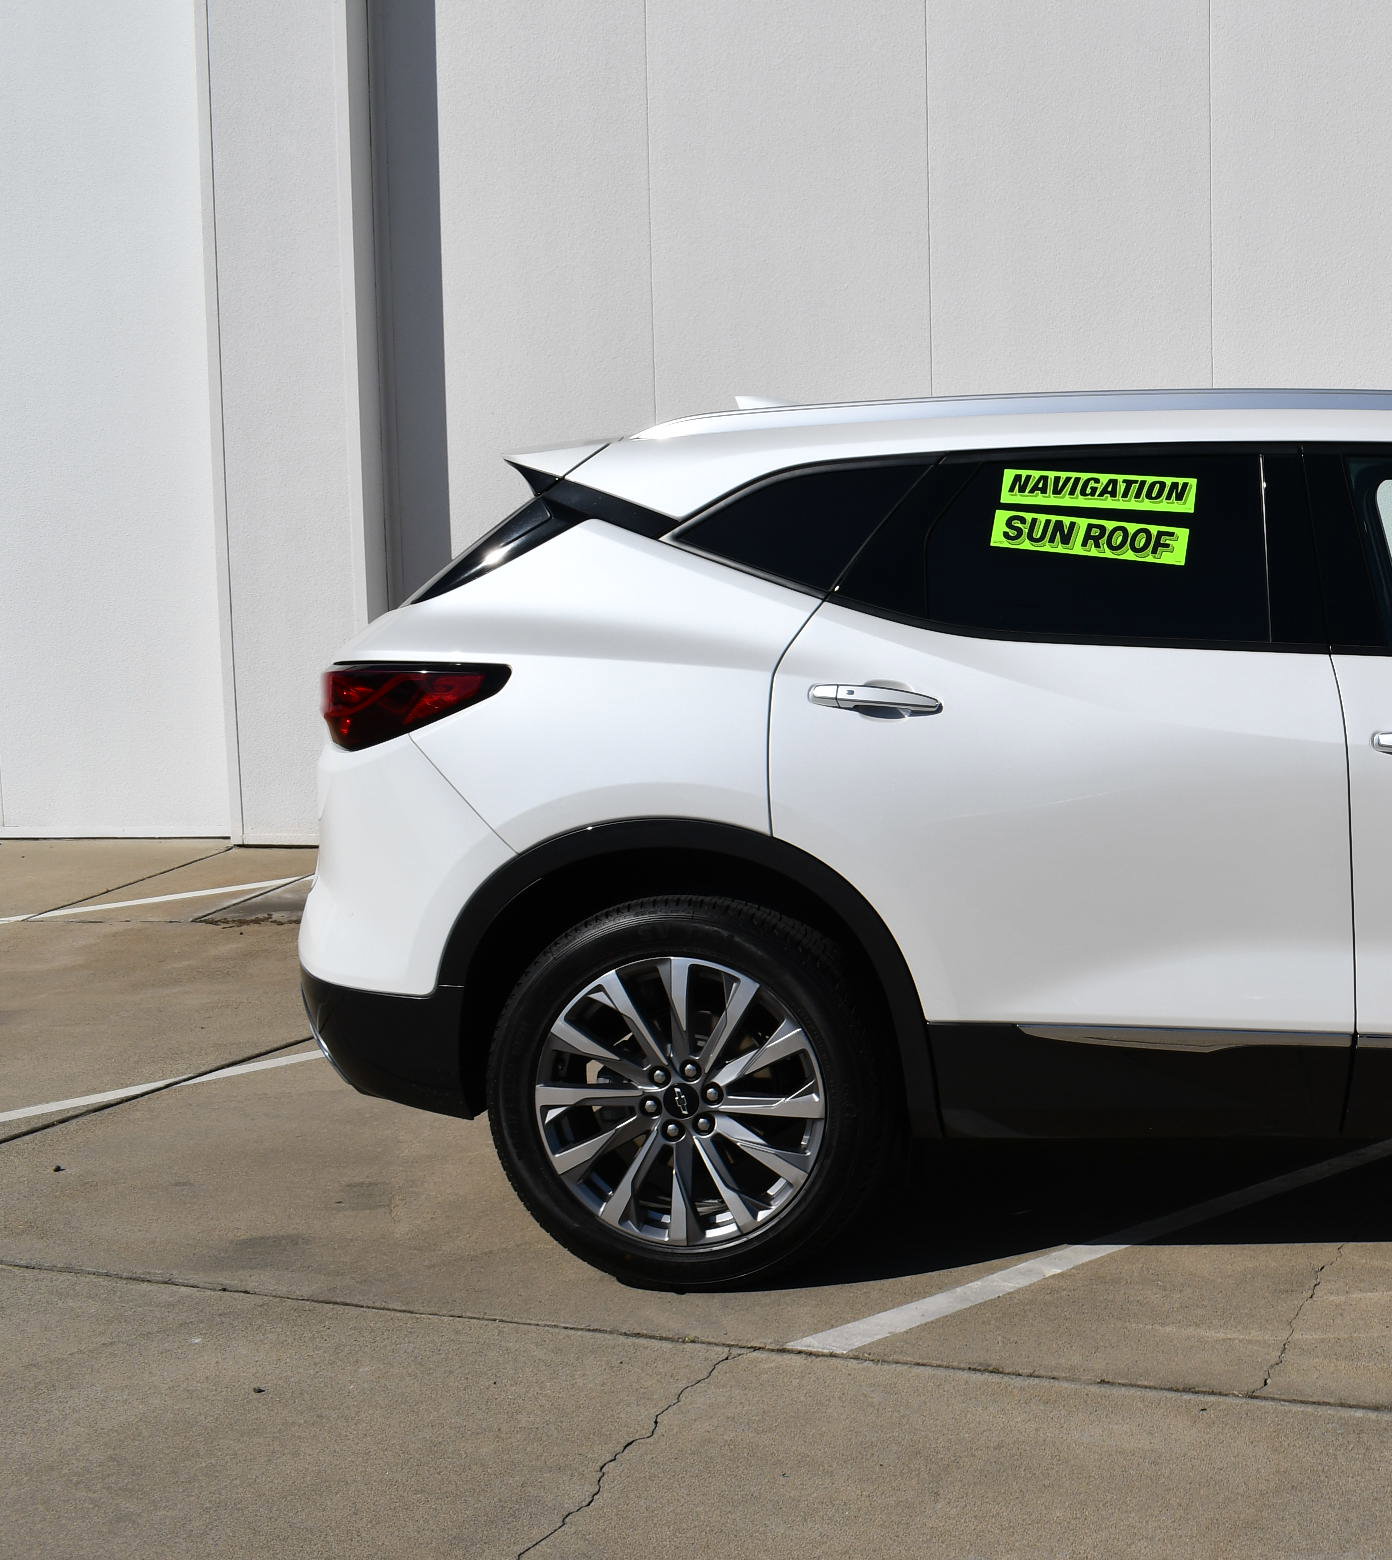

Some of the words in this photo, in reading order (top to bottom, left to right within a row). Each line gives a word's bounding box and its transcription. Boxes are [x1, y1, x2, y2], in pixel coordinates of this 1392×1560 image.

[1008, 473, 1192, 505] NAVIGATION
[1002, 514, 1080, 550] SUN
[1081, 522, 1179, 559] ROOF
